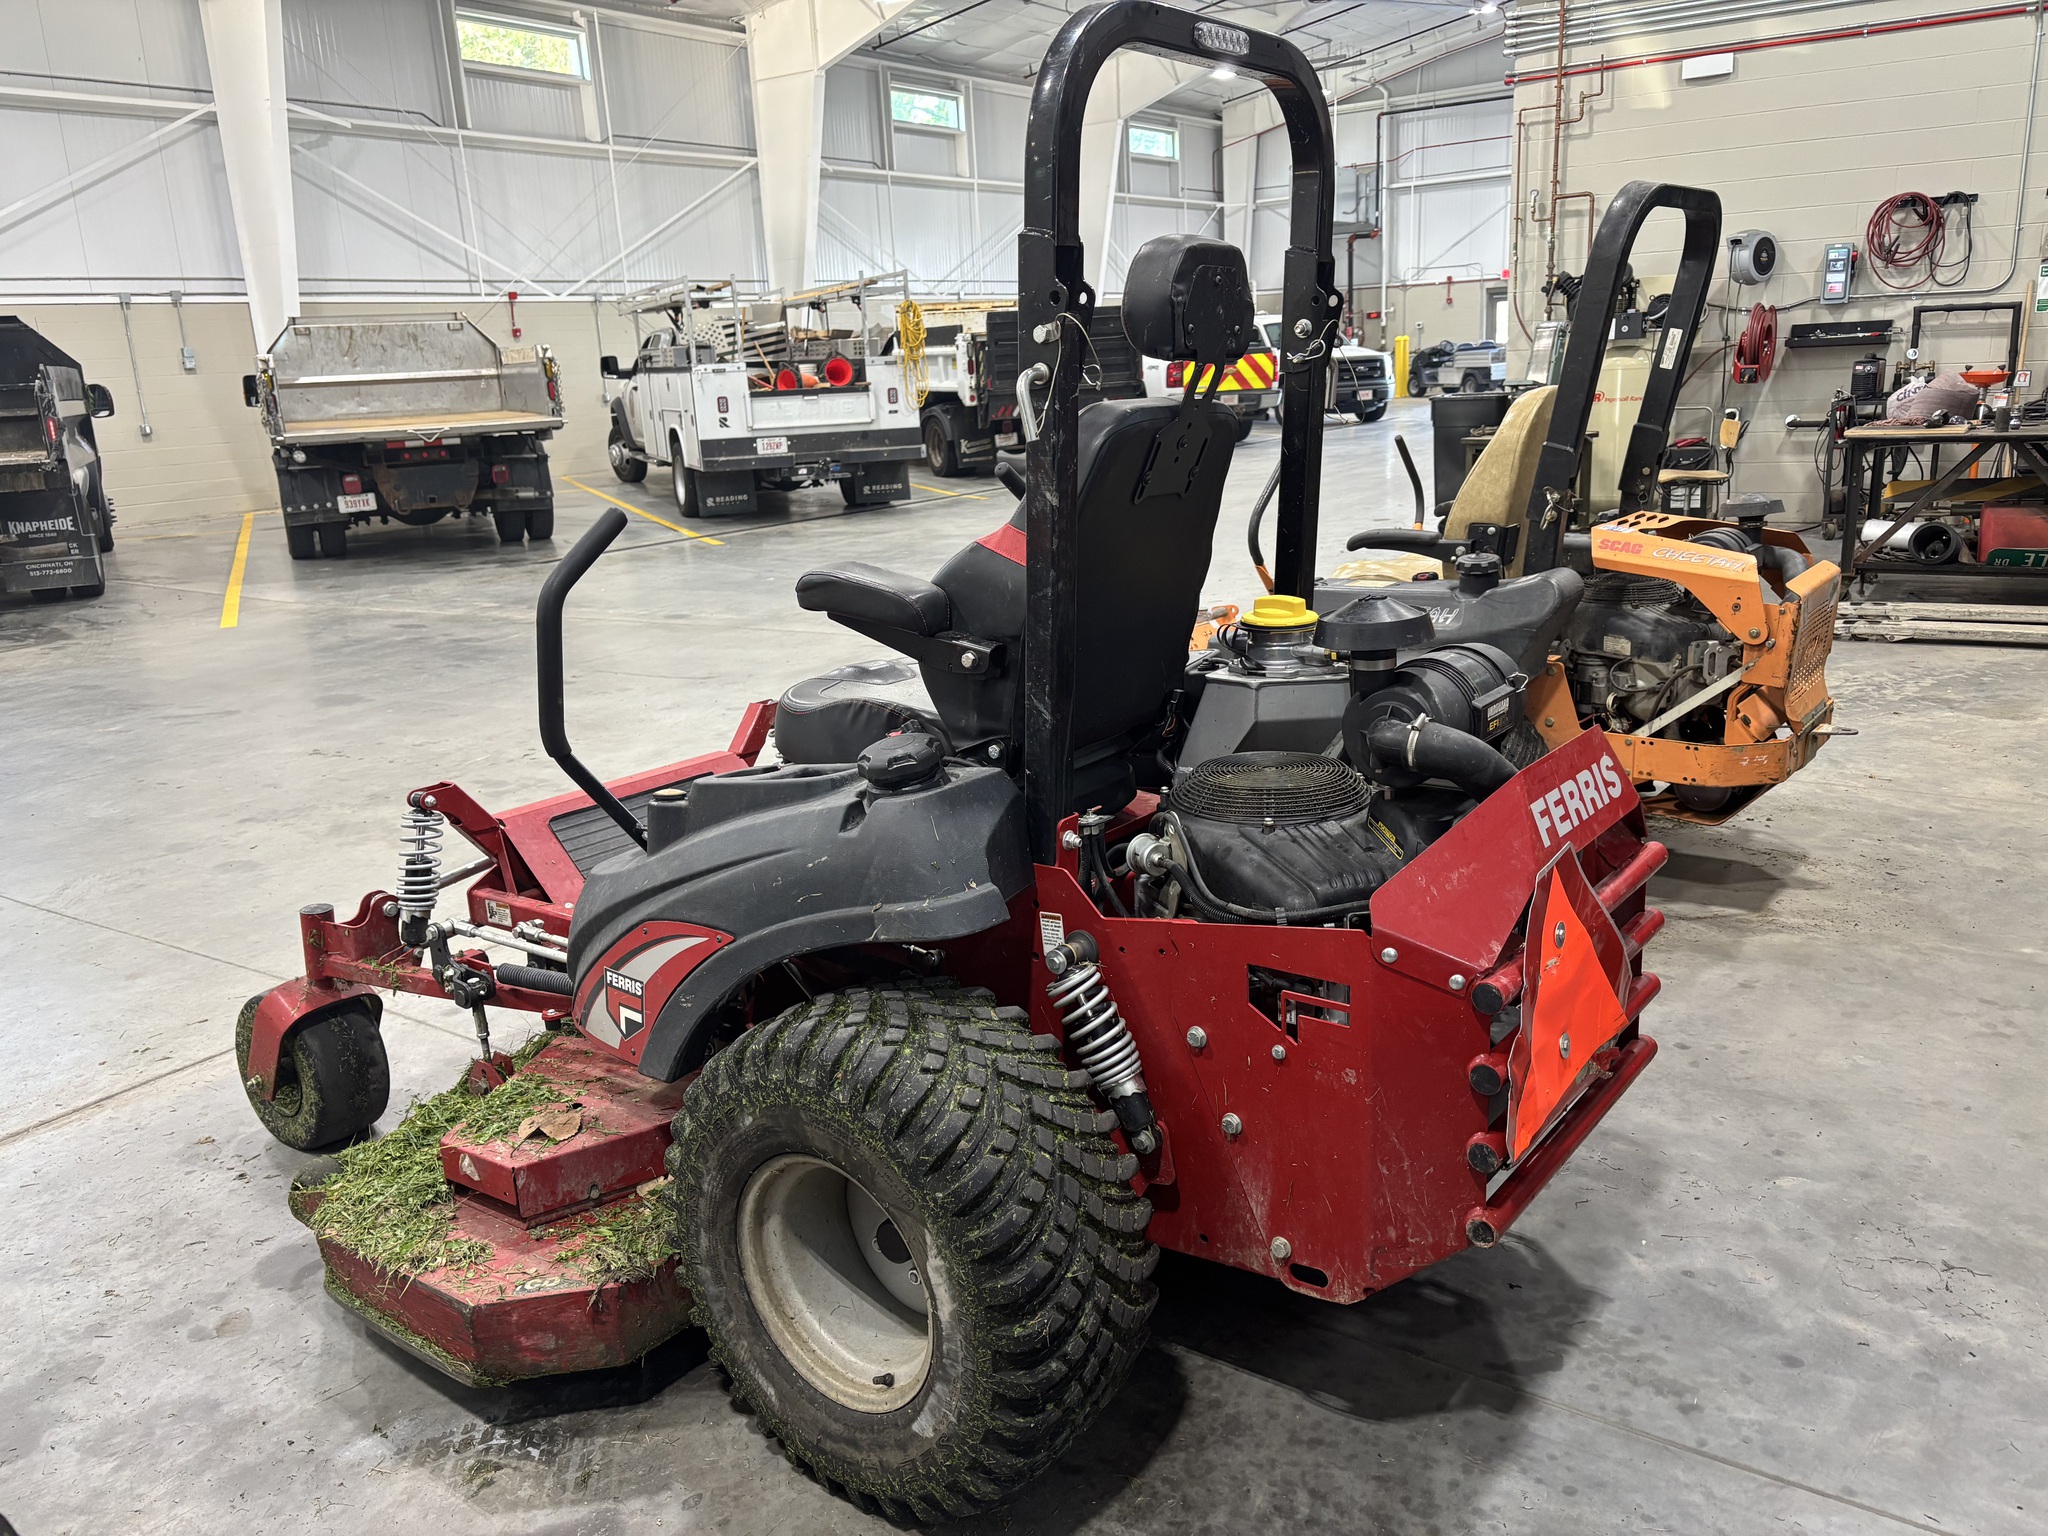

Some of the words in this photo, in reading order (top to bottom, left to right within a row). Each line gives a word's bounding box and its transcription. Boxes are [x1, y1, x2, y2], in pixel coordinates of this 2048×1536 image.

[715, 493, 748, 503] READING
[8, 516, 76, 534] KNAPHEIDE
[1598, 538, 1643, 555] SCAG
[1652, 547, 1745, 571] CHEETAH
[1530, 754, 1622, 848] FERRIS
[606, 971, 642, 996] FERRIS
